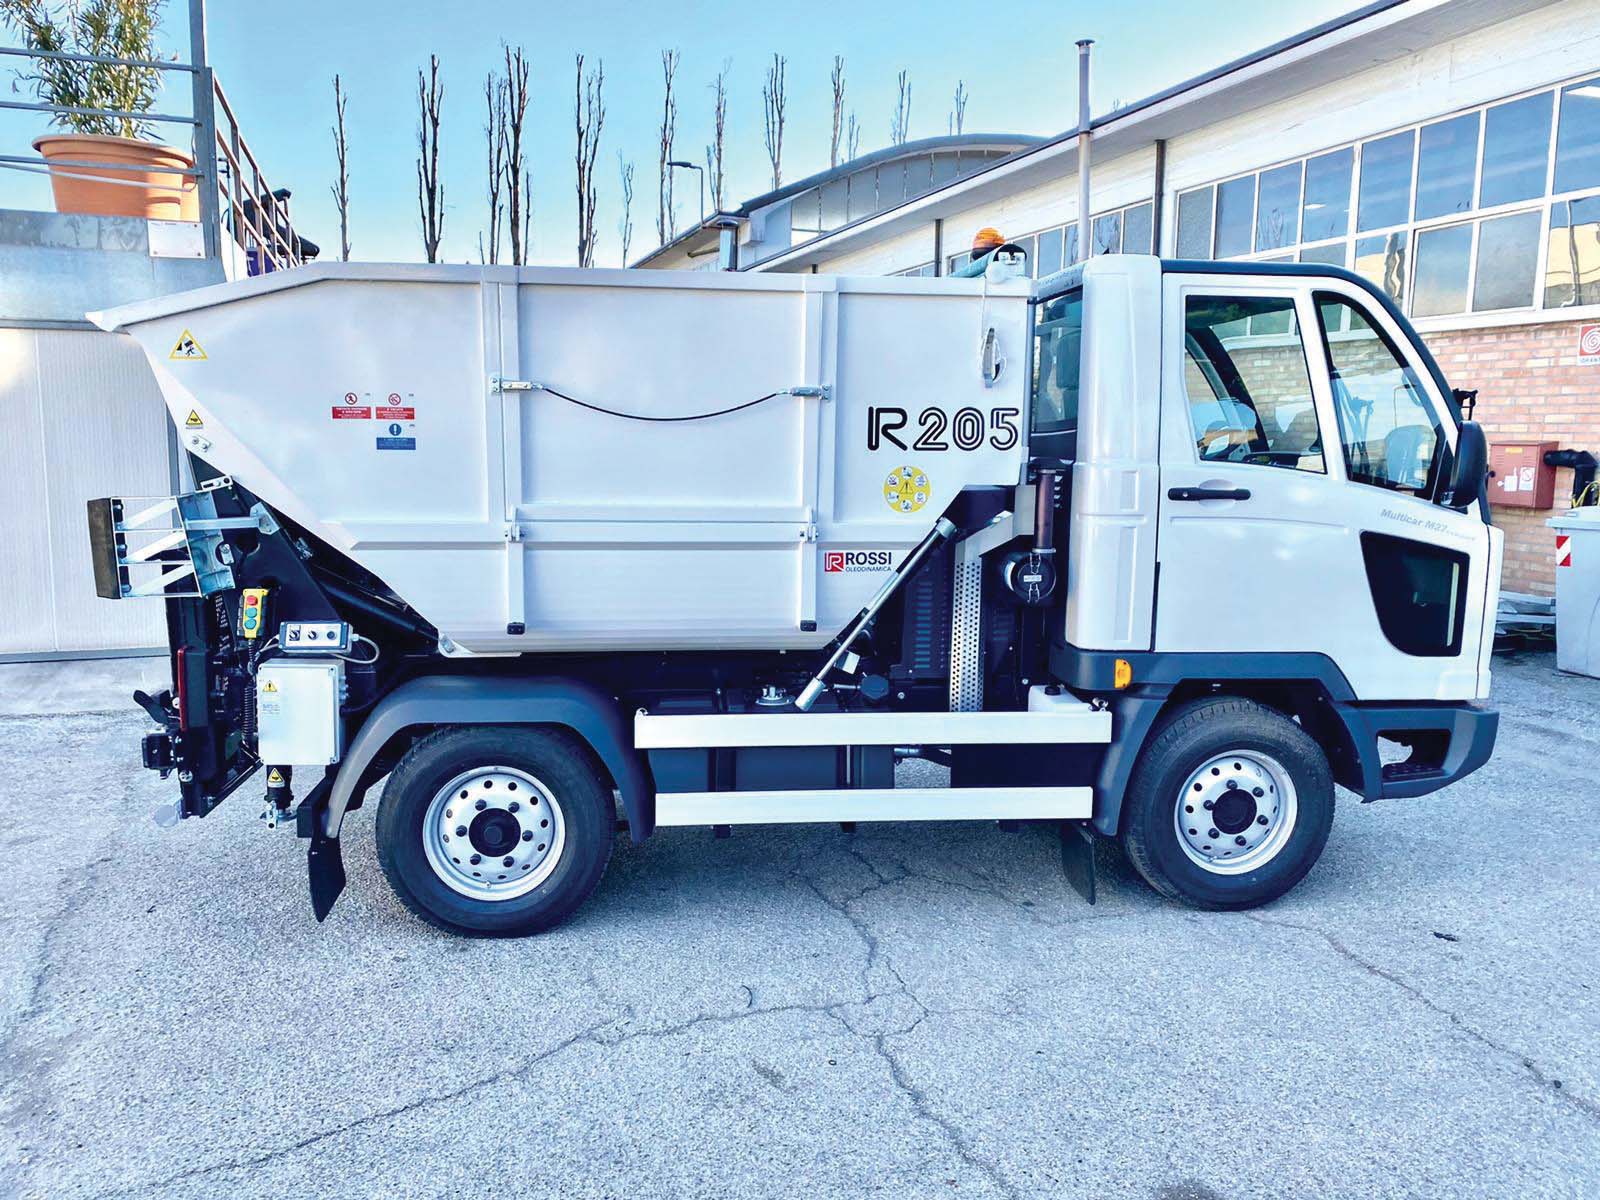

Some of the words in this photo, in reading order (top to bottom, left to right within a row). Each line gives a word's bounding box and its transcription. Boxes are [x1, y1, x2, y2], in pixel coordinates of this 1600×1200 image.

[867, 406, 1019, 451] R205
[1381, 508, 1423, 526] Multicar
[1425, 520, 1447, 534] M27
[845, 552, 892, 565] ROSSI
